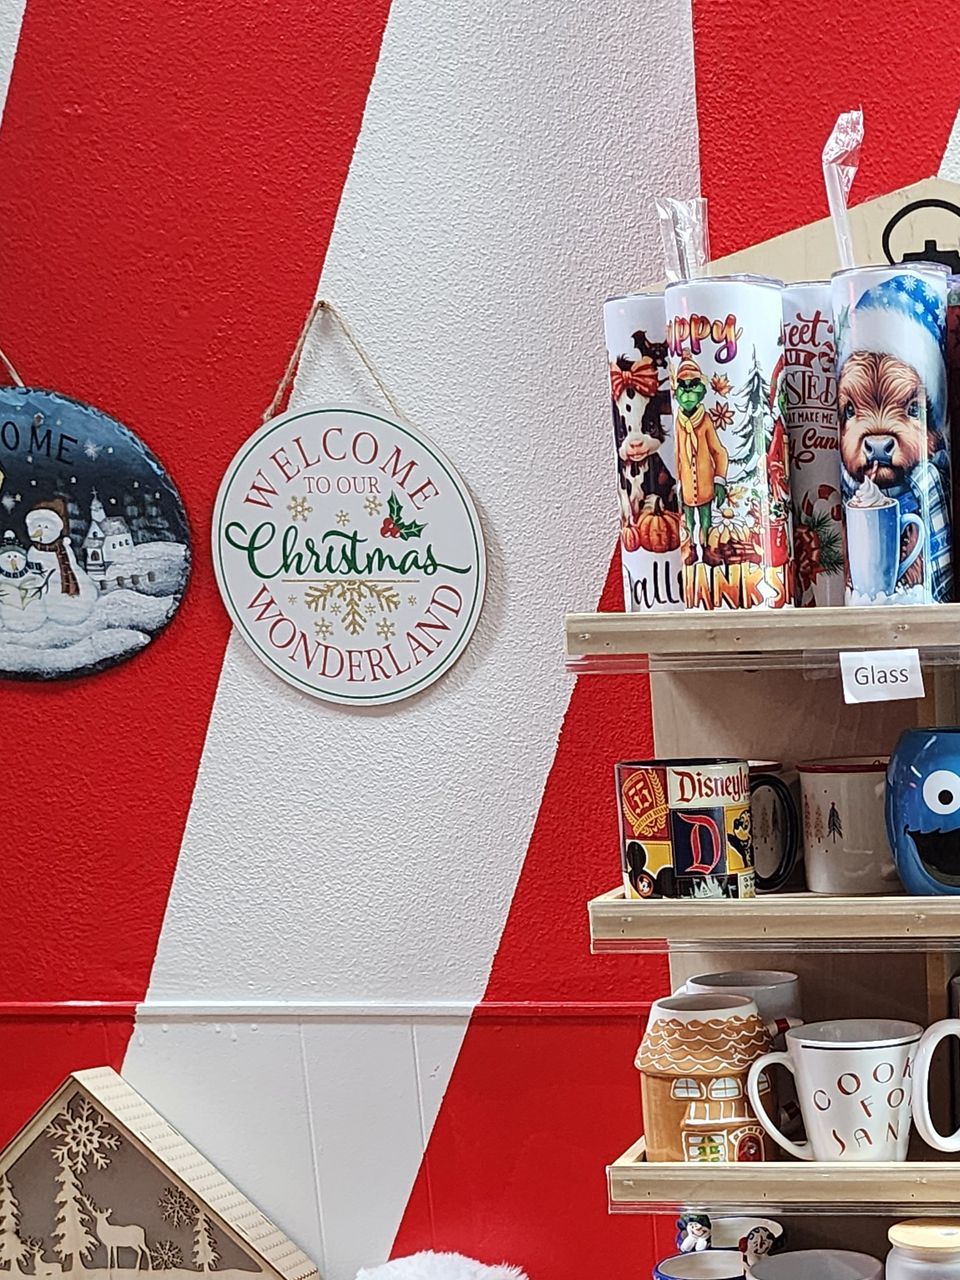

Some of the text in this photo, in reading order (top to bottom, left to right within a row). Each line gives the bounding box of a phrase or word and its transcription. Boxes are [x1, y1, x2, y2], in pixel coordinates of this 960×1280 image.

[782, 310, 829, 347] eet
[798, 411, 820, 423] MAKE
[822, 411, 834, 423] ME
[801, 426, 838, 451] Can
[243, 427, 440, 511] WELCOME
[303, 476, 381, 495] TO OUR
[224, 521, 472, 579] Christmas
[247, 582, 464, 683] WONDERLAND
[854, 665, 909, 686] Glass
[676, 811, 721, 875] D
